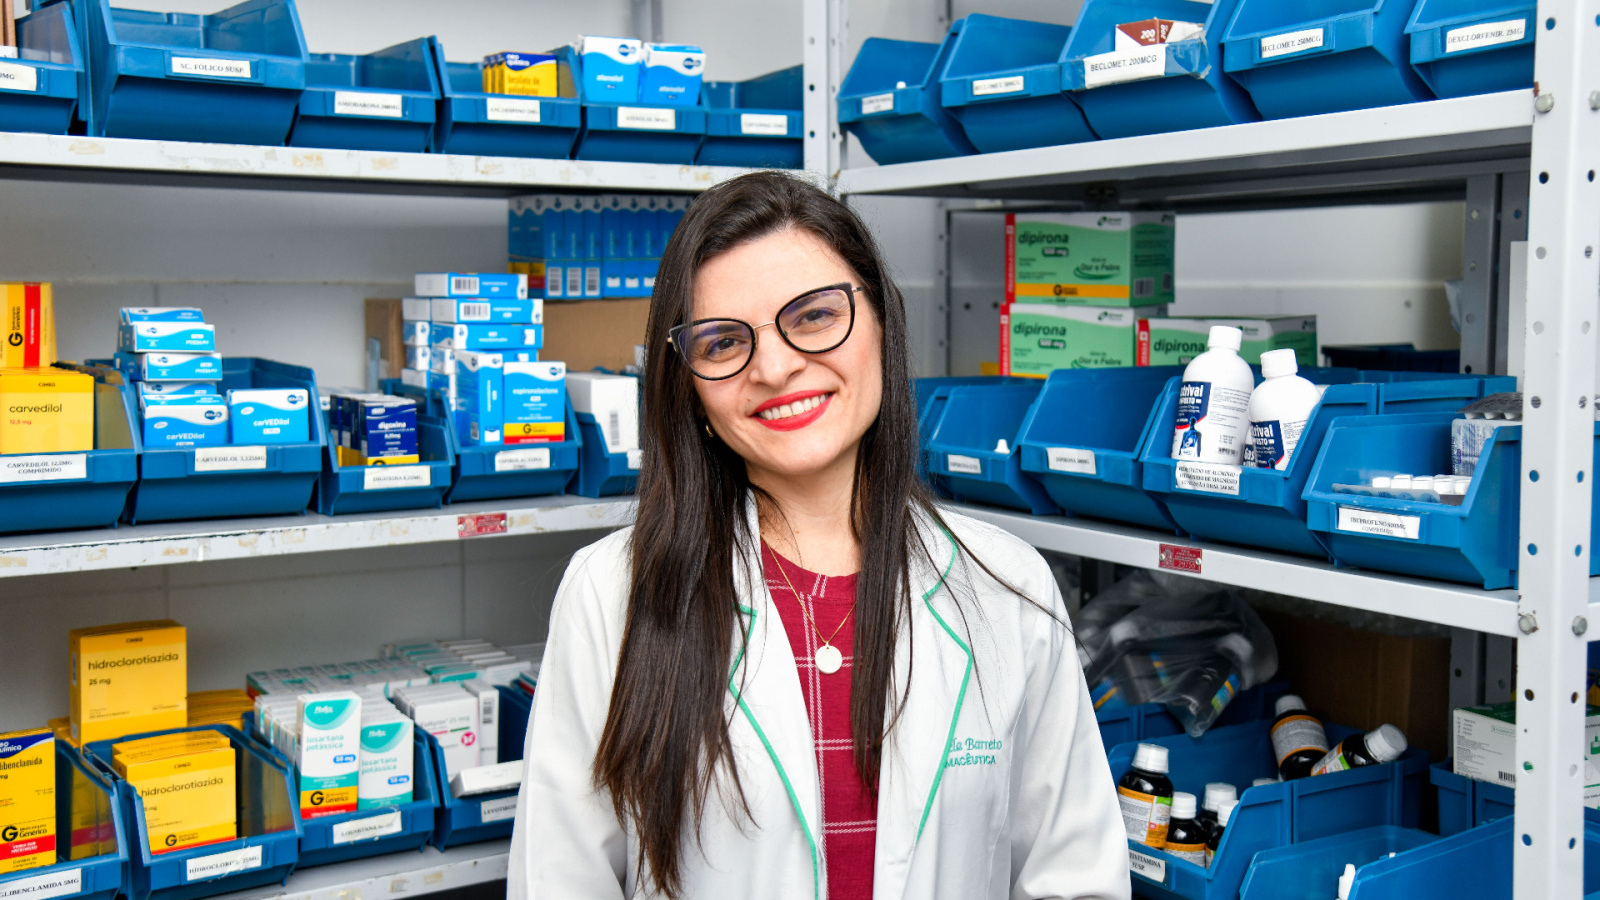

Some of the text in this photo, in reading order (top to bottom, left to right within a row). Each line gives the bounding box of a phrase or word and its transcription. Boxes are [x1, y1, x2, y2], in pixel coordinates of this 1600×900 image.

[1141, 29, 1156, 39] 200
[1090, 54, 1158, 71] BECLOMET. 200MCG
[1018, 231, 1069, 246] dipirona
[1014, 322, 1066, 337] dipirona
[8, 332, 23, 347] G
[1154, 338, 1205, 354] dipirona
[9, 403, 62, 412] carvedilol
[253, 418, 290, 426] carVEDilol
[378, 421, 406, 429] digoxina
[88, 652, 179, 670] hidroclorotiazida
[307, 734, 344, 743] losartana
[965, 738, 1003, 751] Barreto
[0, 757, 42, 770] libenclamida
[361, 757, 397, 766] losartana
[945, 752, 996, 768] MACÊUTICA
[141, 777, 223, 797] hidroclorotiazida
[310, 791, 324, 806] G
[2, 826, 18, 842] G
[165, 833, 177, 847] G
[0, 882, 62, 898] GLIBENCLAMIDA
